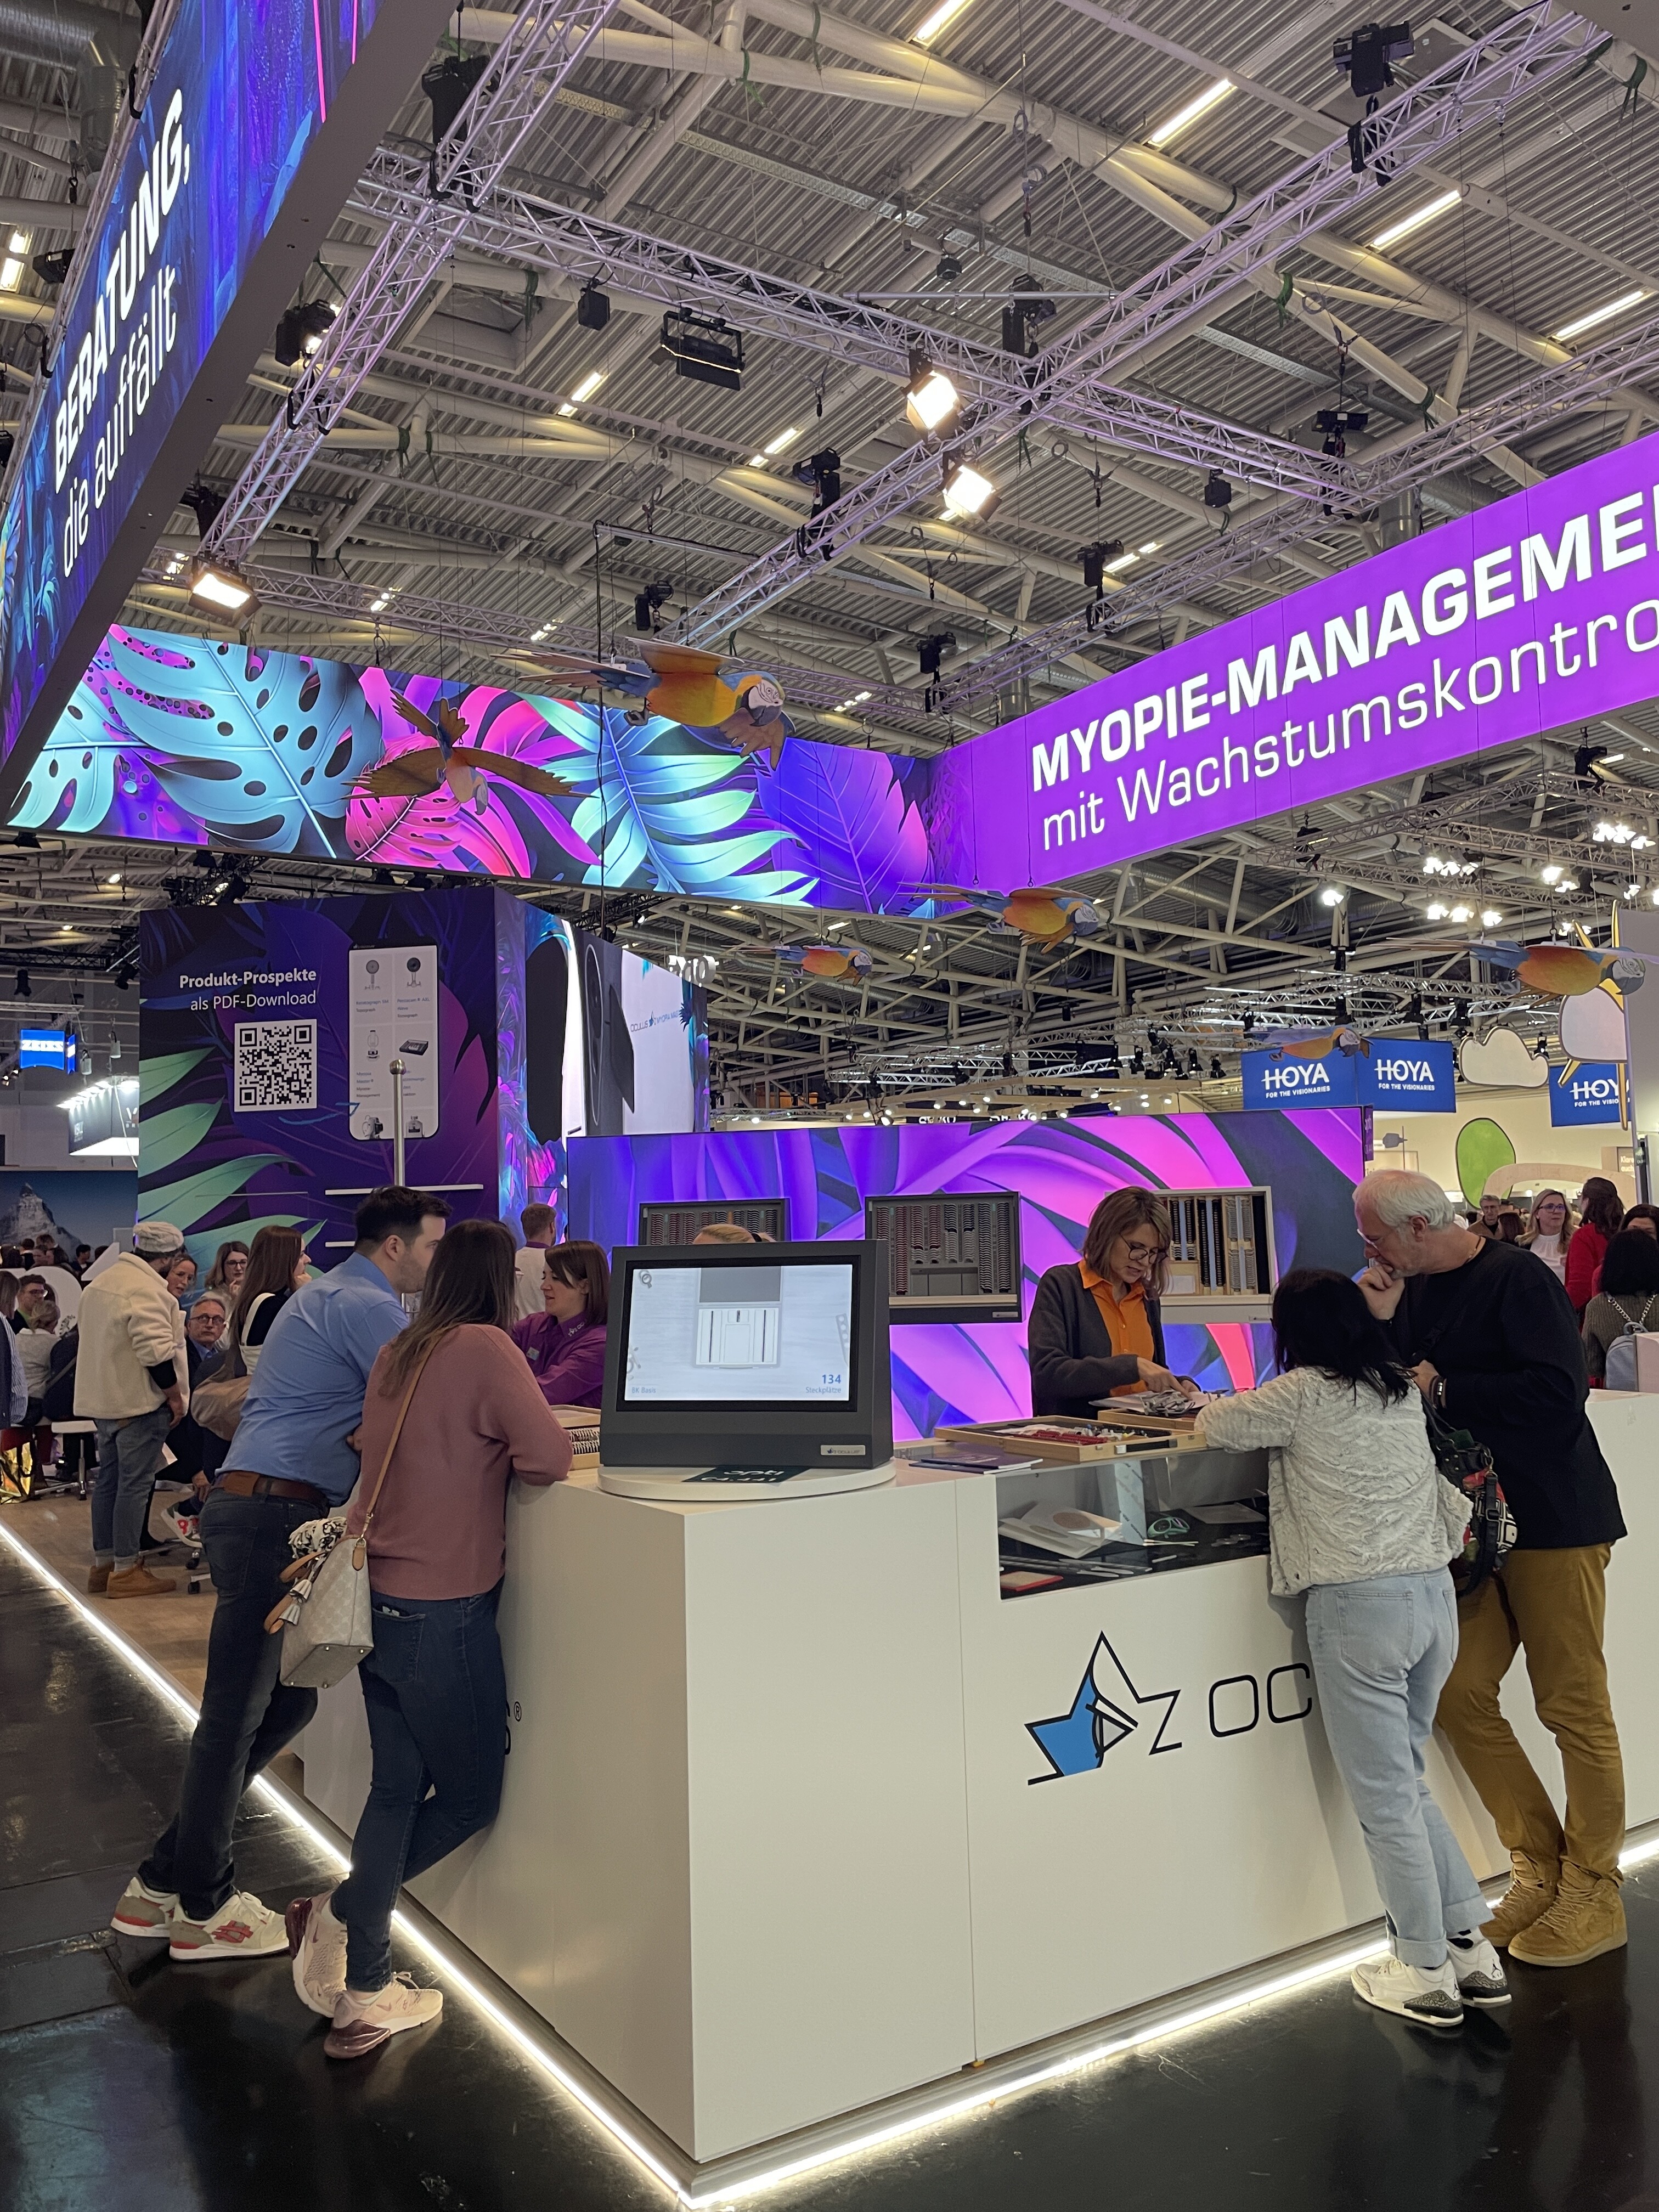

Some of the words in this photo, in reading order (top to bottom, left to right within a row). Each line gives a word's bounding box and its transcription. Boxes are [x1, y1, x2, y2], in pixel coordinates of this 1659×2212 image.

[55, 88, 190, 495] BERATUNG,
[63, 476, 89, 578] die
[94, 264, 178, 510] auffällt
[1031, 483, 1659, 792] MYOPIE-MANAGEME
[1042, 791, 1105, 851] mit
[1116, 598, 1659, 822] Wachstumskontro
[179, 968, 317, 989] Produkt-Prospekte
[190, 996, 208, 1011] als
[213, 990, 317, 1009] PDF-Download
[21, 1040, 64, 1052] ZEISS
[1261, 1062, 1330, 1090] HOYA
[1374, 1059, 1435, 1082] HOYA
[1293, 1086, 1330, 1096] VISIONARIES
[1569, 1079, 1624, 1100] HOY
[822, 1374, 842, 1384] 134
[805, 1386, 842, 1395] Steckplätze
